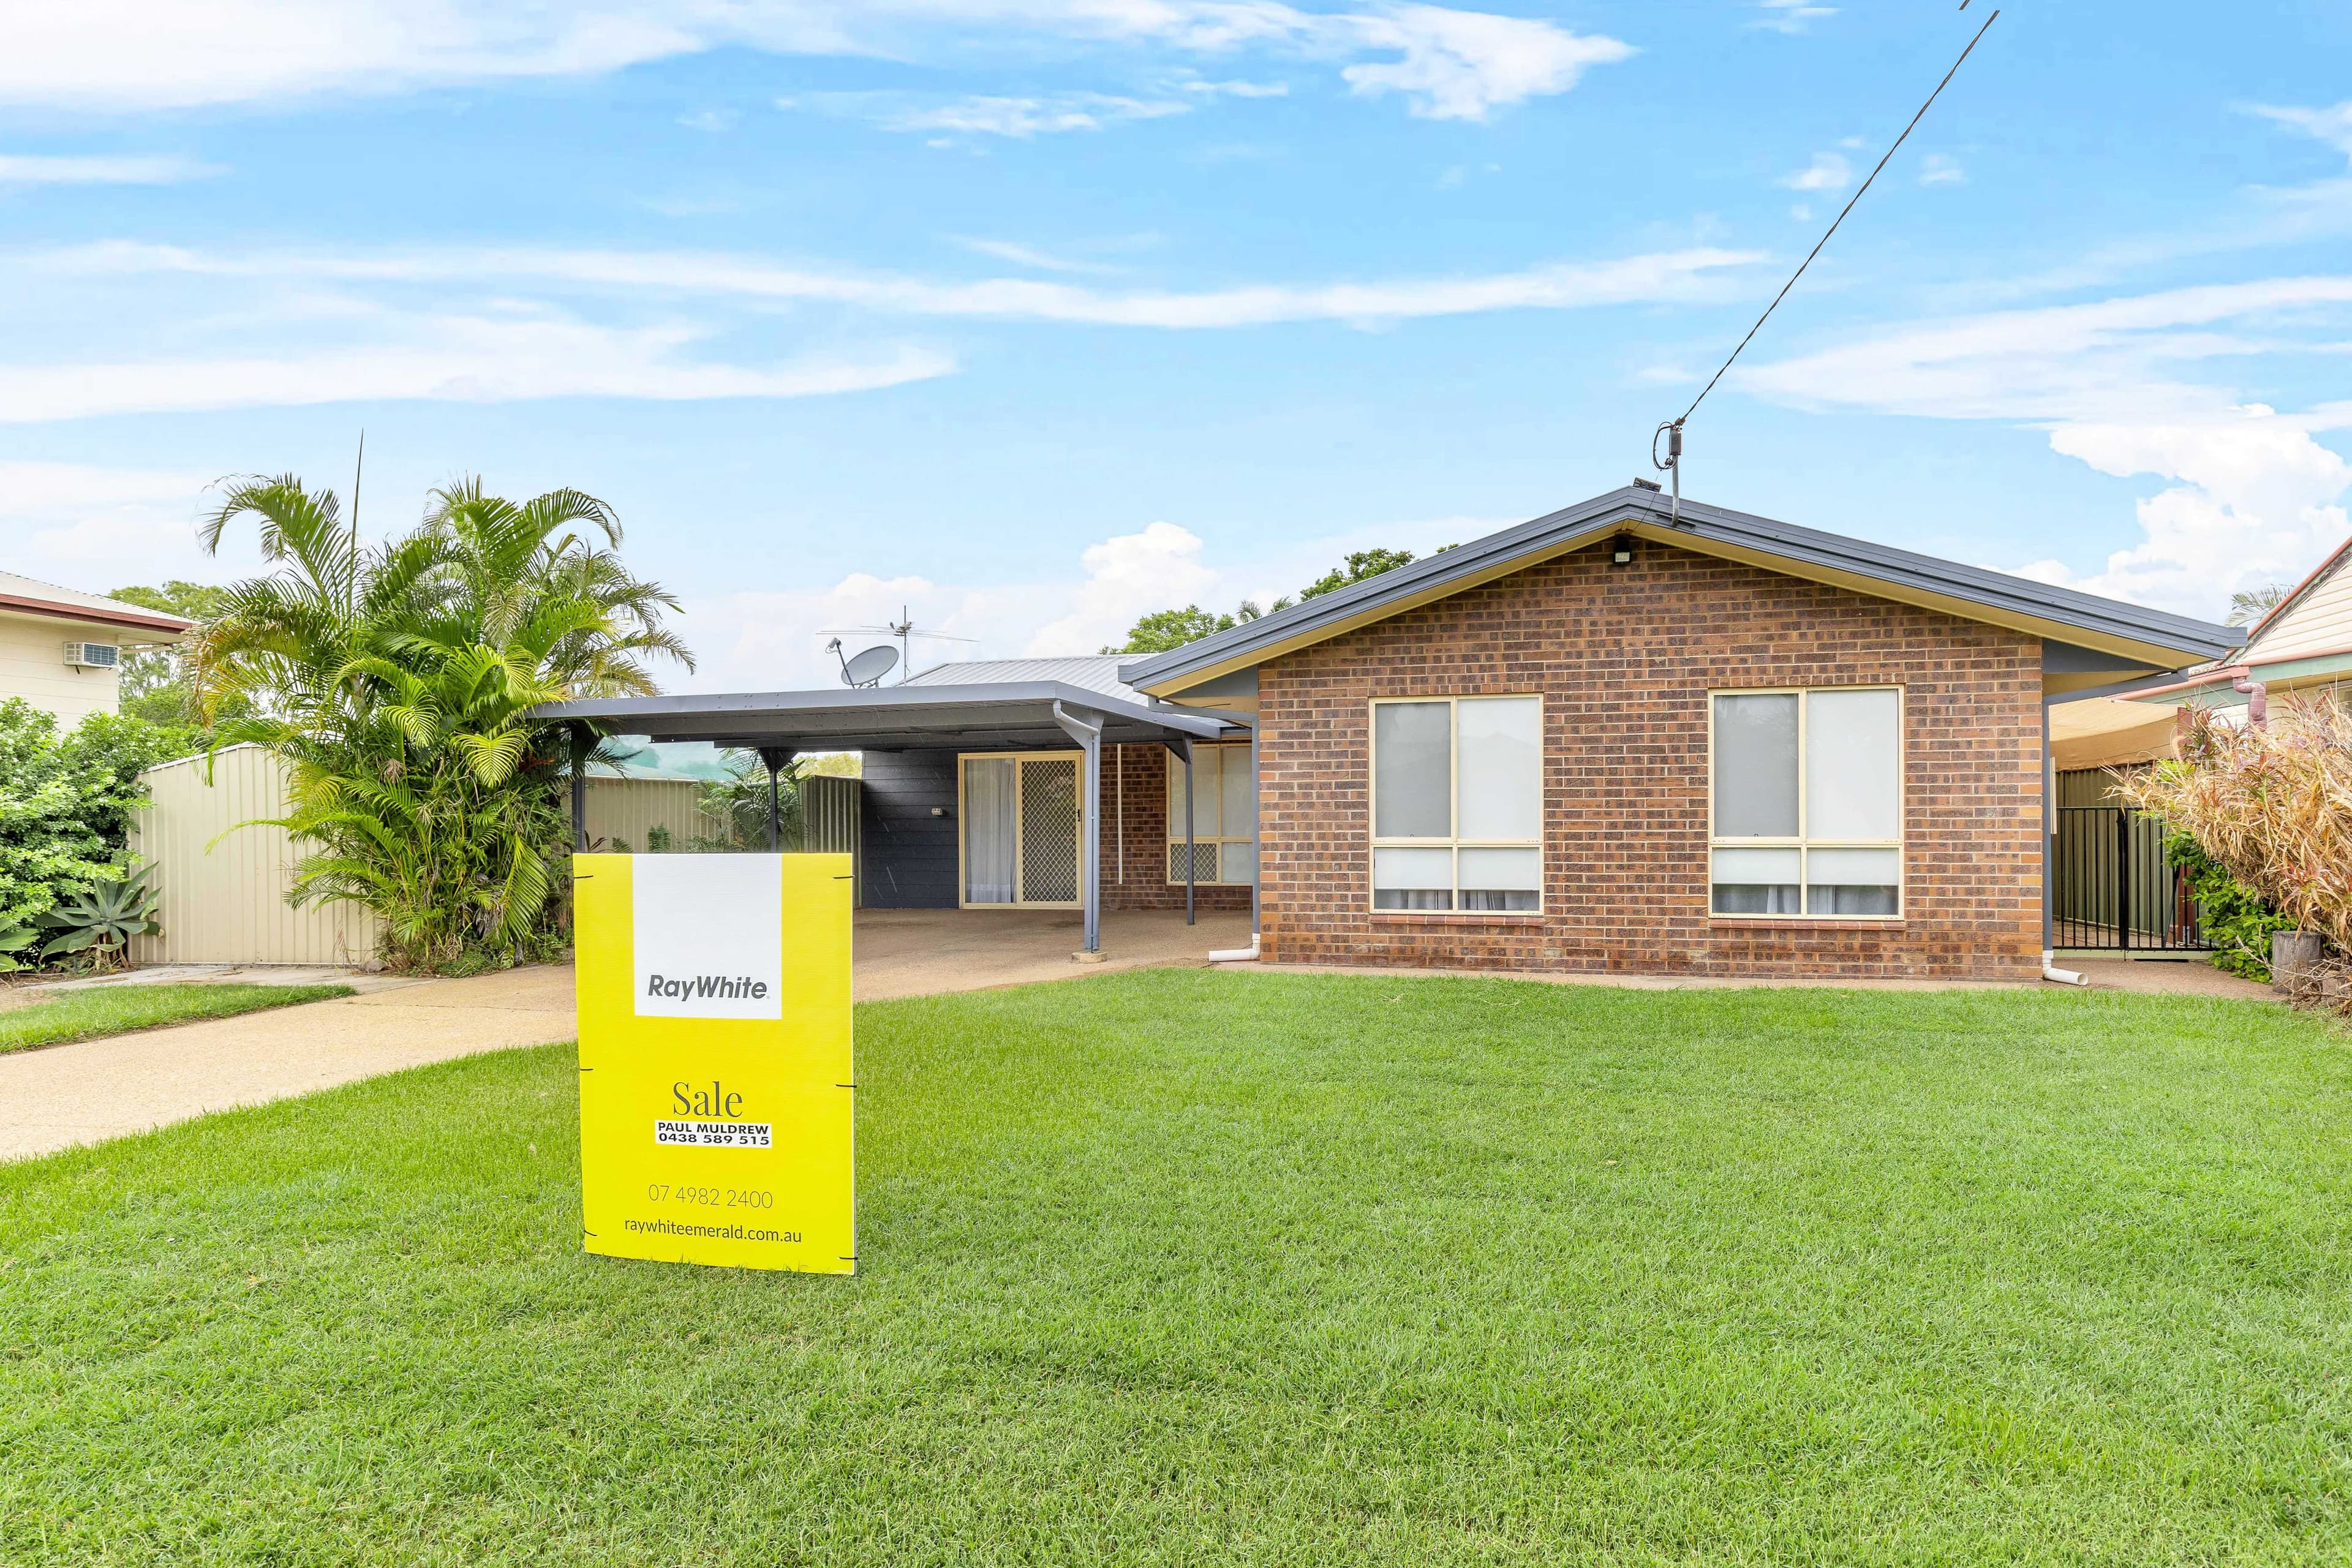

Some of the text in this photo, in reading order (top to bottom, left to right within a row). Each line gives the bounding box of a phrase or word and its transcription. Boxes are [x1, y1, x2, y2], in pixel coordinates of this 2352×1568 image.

[648, 974, 767, 1002] RayWhite
[673, 1080, 743, 1118] Sale
[658, 1121, 769, 1135] PAUL MULDREW
[658, 1133, 769, 1145] 0438 589 515
[649, 1184, 773, 1208] 07 4982 2400
[625, 1218, 801, 1243] raywhiteemerald.com.au
